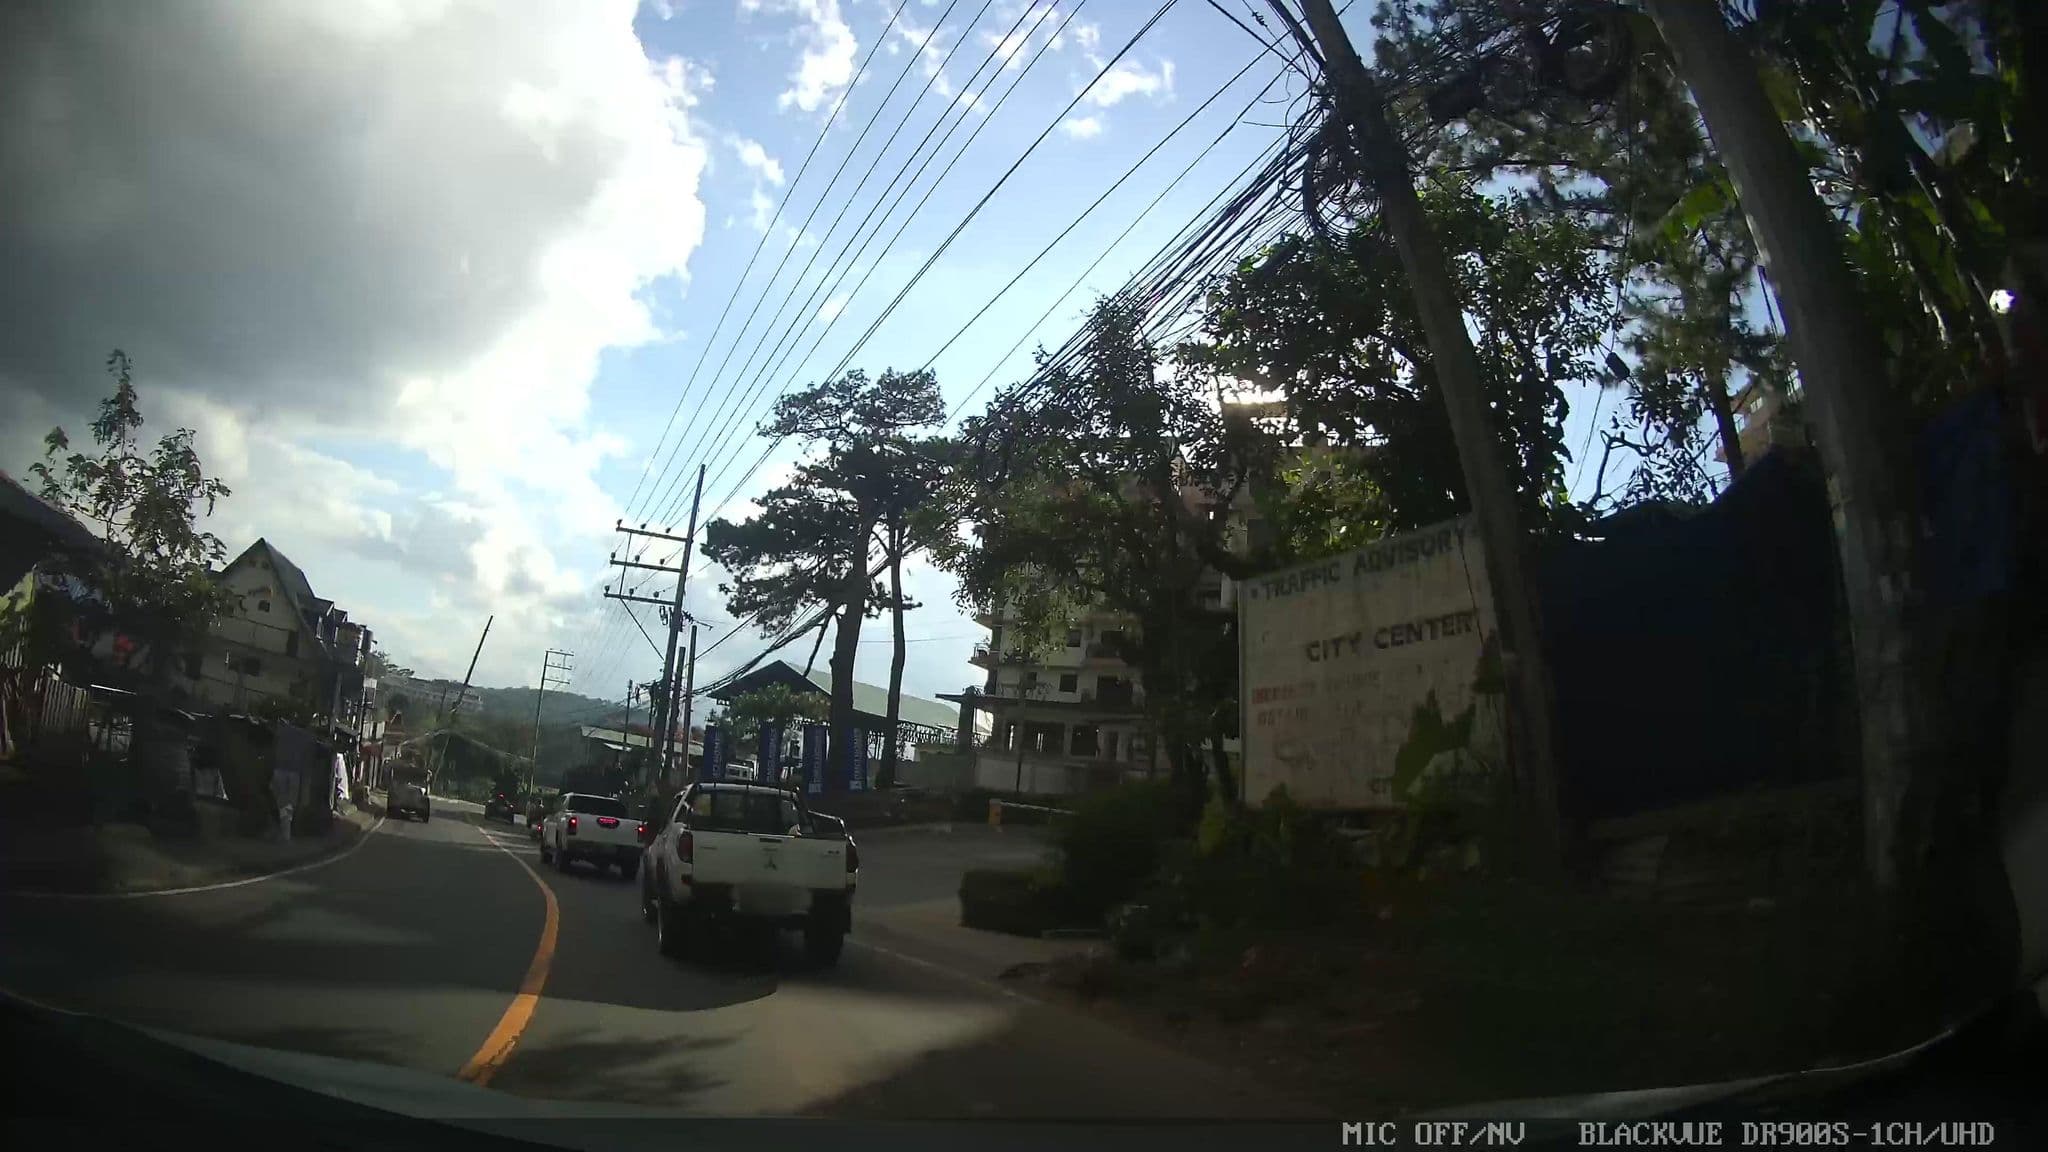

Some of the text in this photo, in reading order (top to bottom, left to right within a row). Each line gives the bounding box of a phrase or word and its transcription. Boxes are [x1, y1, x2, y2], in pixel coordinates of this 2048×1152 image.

[1260, 525, 1466, 601] TRAFFIC ADVISORY
[1305, 609, 1476, 663] CITY CENTER
